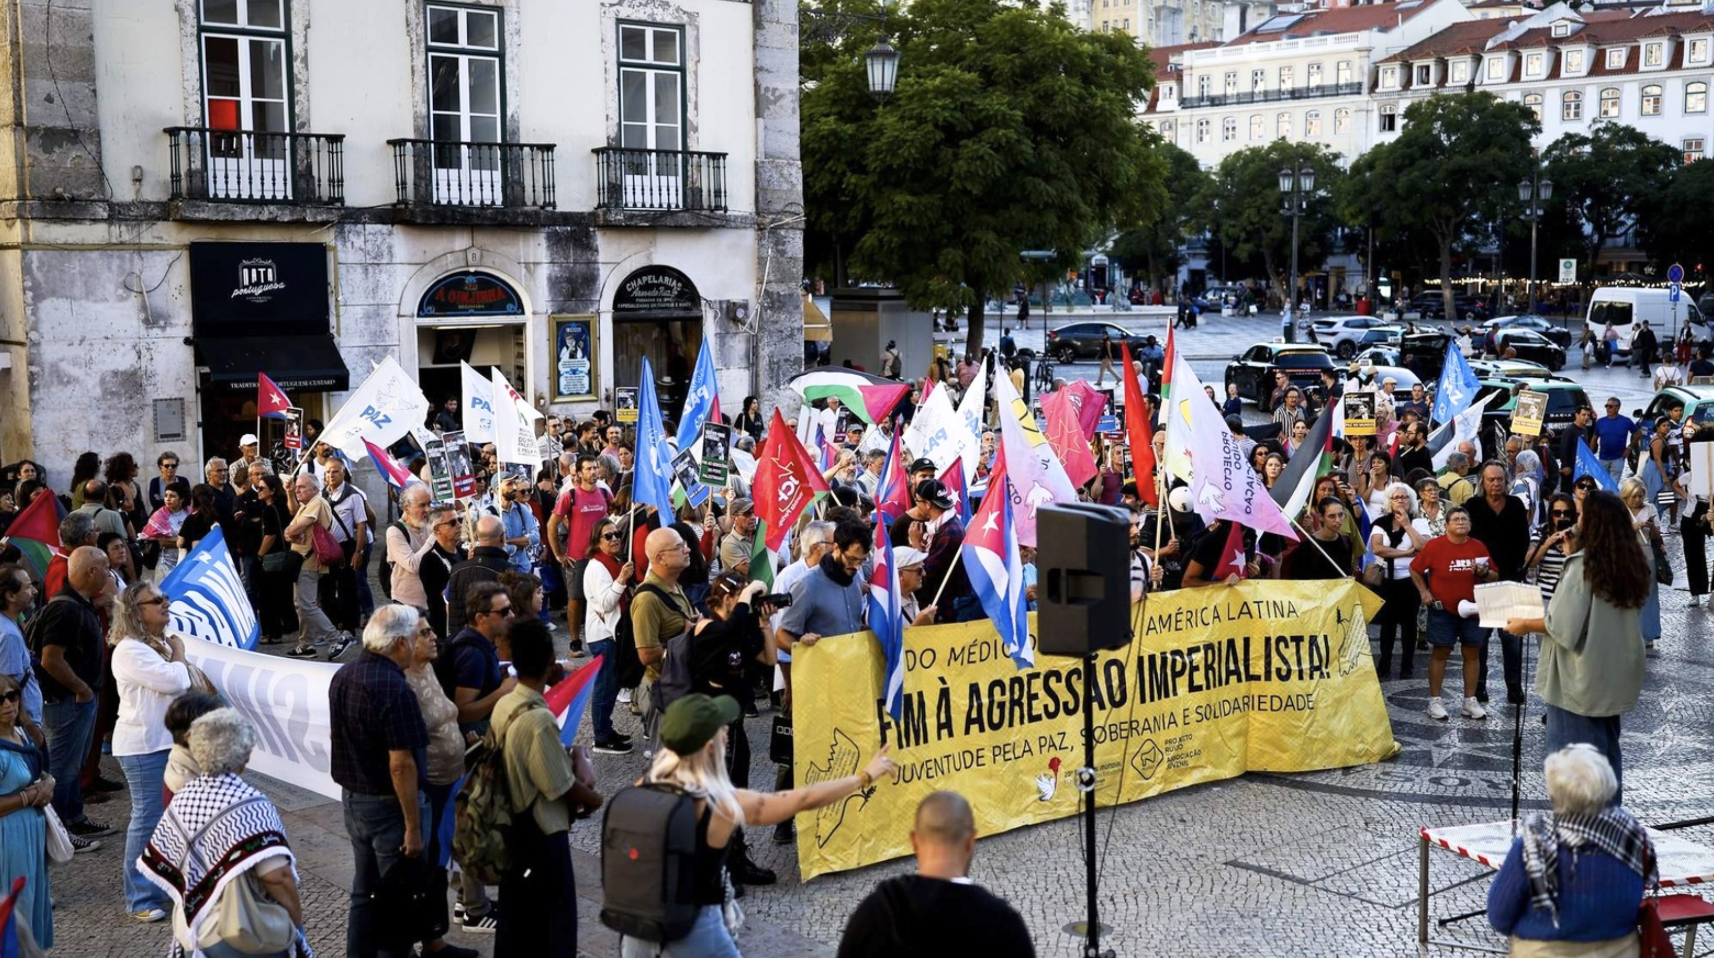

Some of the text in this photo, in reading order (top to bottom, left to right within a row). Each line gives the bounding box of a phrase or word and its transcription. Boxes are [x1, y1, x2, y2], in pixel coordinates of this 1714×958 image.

[473, 253, 477, 262] 8
[626, 275, 682, 292] CHAPELARIAS
[1672, 286, 1678, 300] P
[471, 396, 495, 415] PA
[359, 405, 392, 429] PAZ
[905, 648, 936, 672] DO
[1146, 605, 1222, 636] AMÉRICA
[1227, 600, 1300, 621] LATINA
[936, 676, 954, 741] À
[1137, 634, 1331, 704] IMPERIALISTA!
[892, 693, 1315, 786] JUVENTUDE PELA PAZ, SOBERANIA E SOLIDARIEDADE
